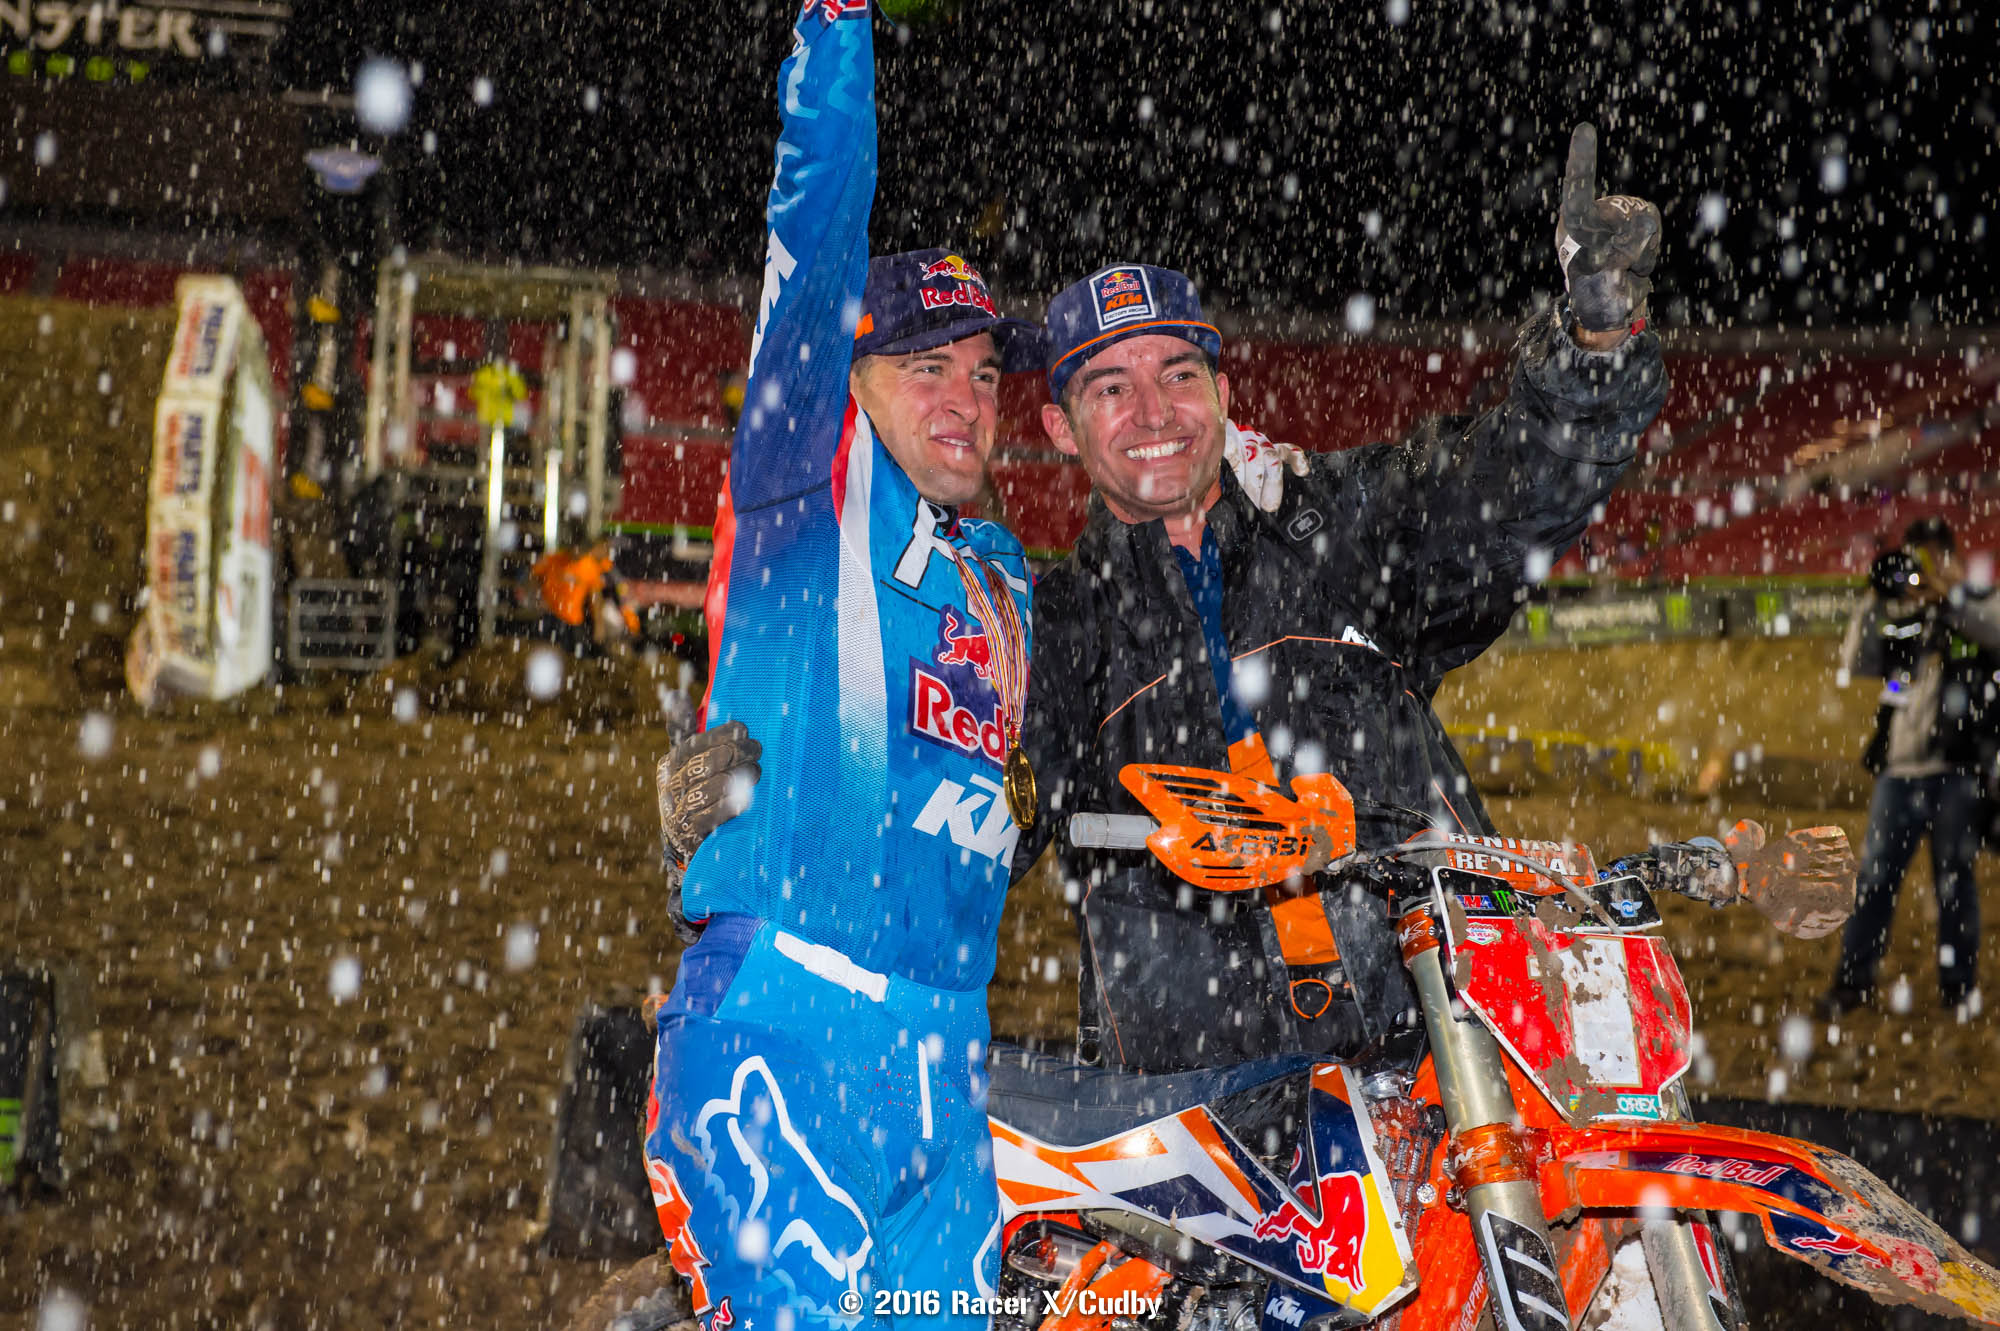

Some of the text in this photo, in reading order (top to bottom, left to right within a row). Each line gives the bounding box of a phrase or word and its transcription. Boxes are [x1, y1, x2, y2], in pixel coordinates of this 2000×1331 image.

[920, 281, 997, 318] Red Bu
[1101, 280, 1140, 298] Red Bull
[1105, 292, 1143, 311] KTM
[913, 669, 1007, 766] Red
[1663, 1153, 1790, 1187] Red Bull
[1265, 1295, 1306, 1328] KTM
